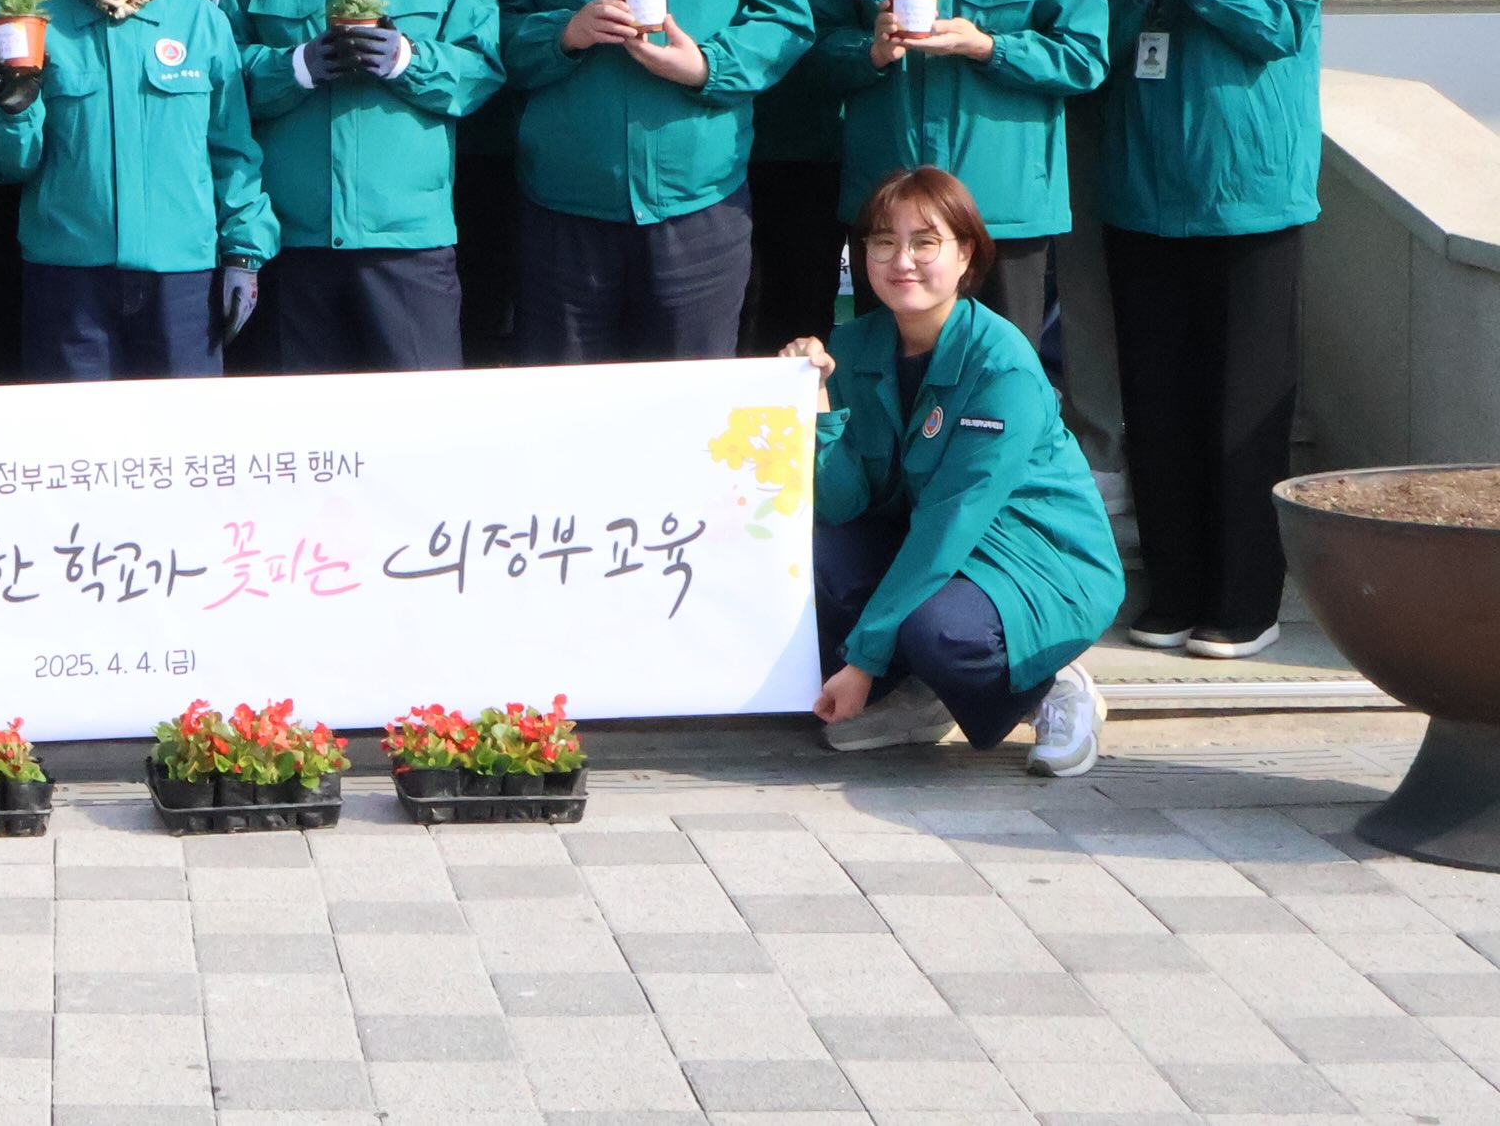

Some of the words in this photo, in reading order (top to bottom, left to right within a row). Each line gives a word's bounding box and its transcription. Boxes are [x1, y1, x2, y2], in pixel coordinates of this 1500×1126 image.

[184, 454, 236, 489] 청렴
[248, 451, 298, 485] 식목
[307, 450, 366, 483] 행사
[53, 521, 208, 604] 학교가
[202, 520, 362, 611] 꽃피는
[382, 513, 594, 595] 의정부
[603, 511, 707, 620] 교육
[34, 653, 99, 679] 2025.
[107, 651, 128, 675] 4.
[136, 650, 157, 674] 4.
[165, 649, 196, 676] (금)
